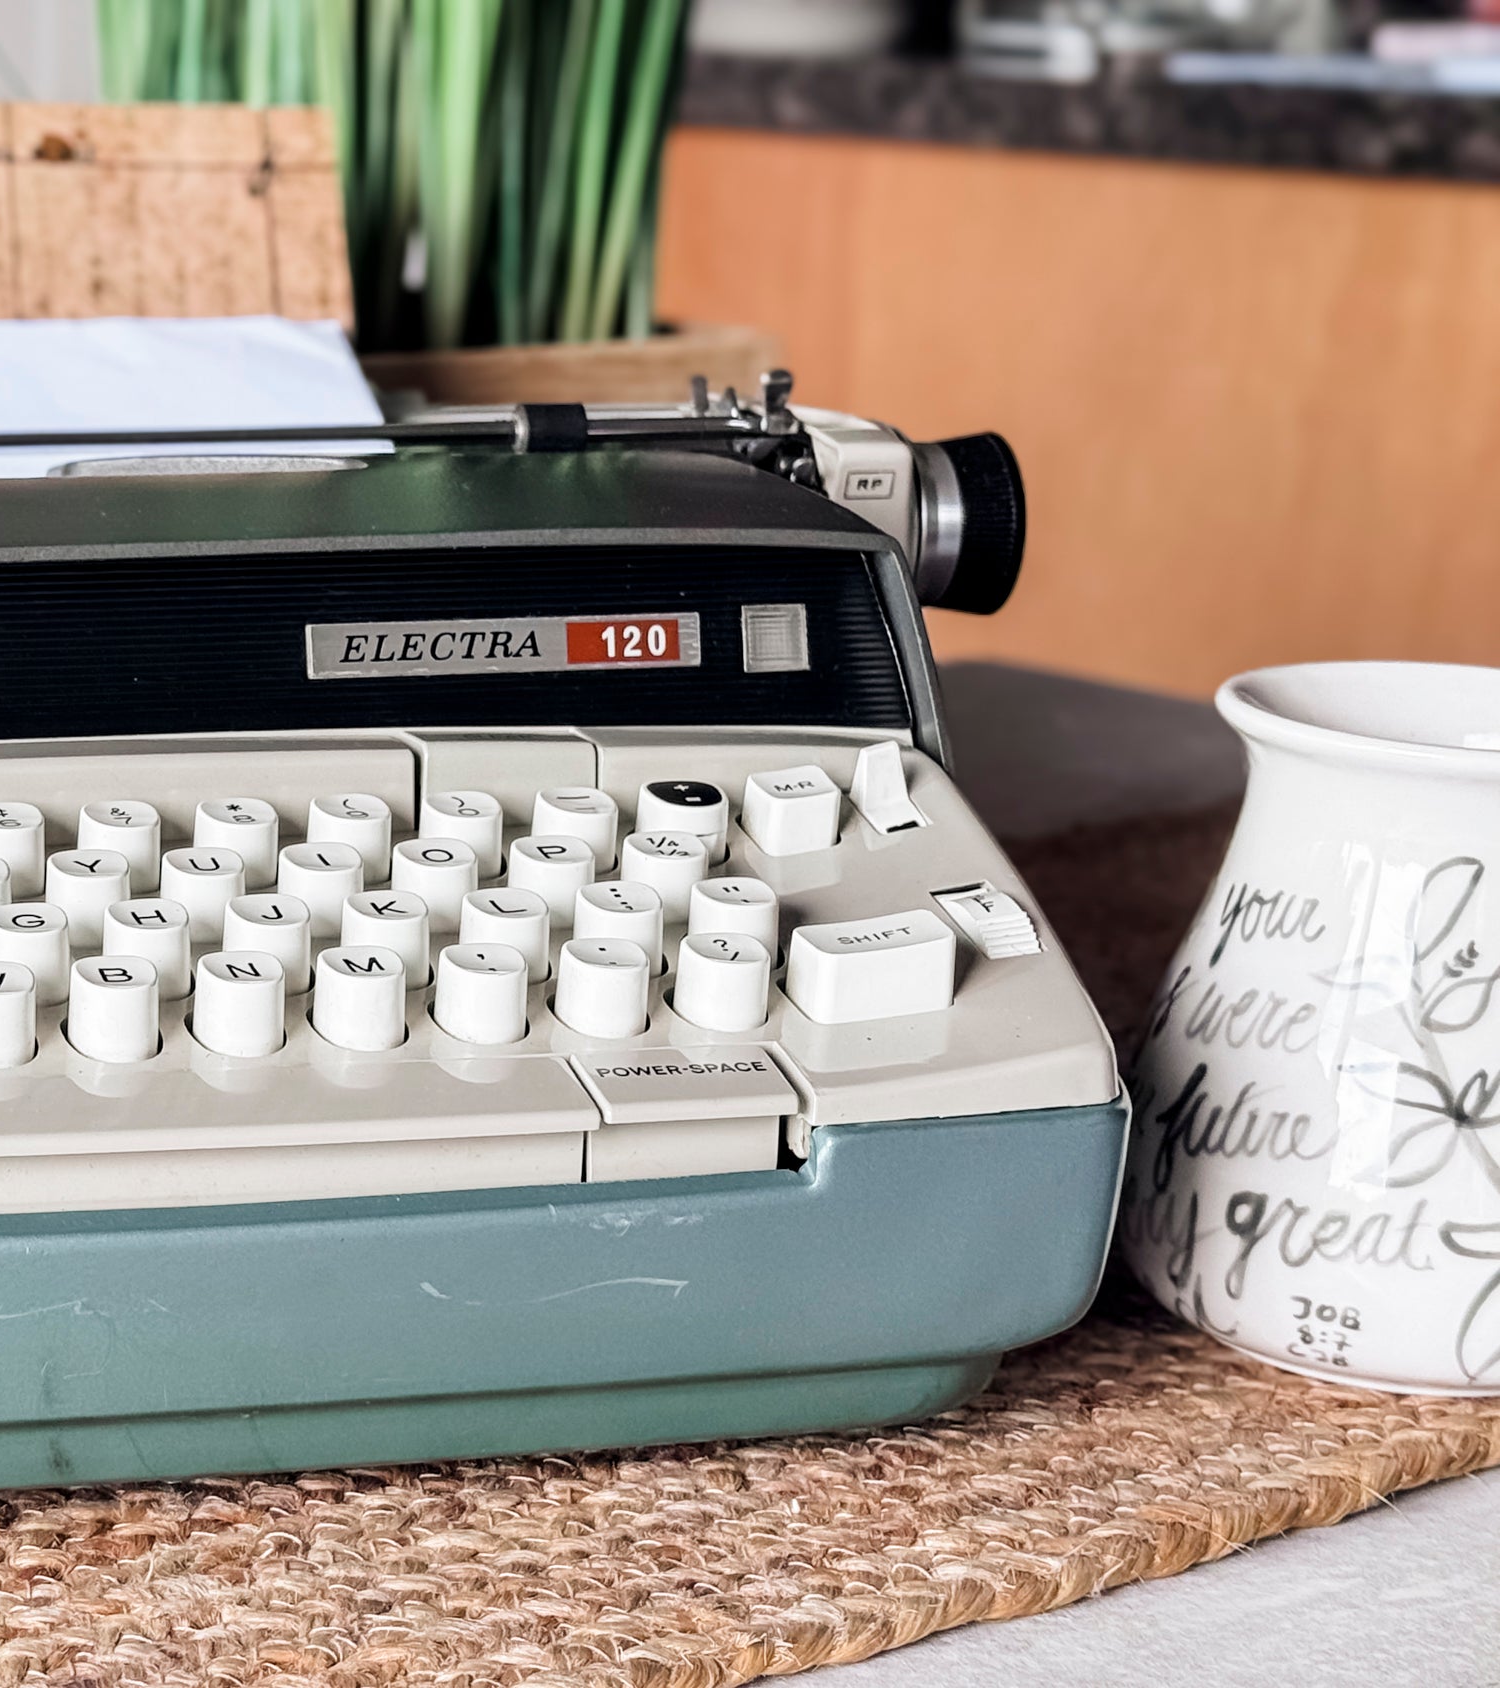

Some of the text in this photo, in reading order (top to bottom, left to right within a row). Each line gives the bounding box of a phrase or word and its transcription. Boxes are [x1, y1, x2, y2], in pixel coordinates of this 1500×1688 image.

[856, 479, 882, 491] RP
[339, 625, 668, 665] ELECTRA 120
[316, 853, 331, 867] I
[421, 849, 454, 863] O
[536, 845, 568, 860] P
[74, 859, 102, 873] Y
[188, 857, 221, 872] U
[260, 905, 284, 920] J
[369, 900, 409, 915] K
[489, 900, 528, 914] L
[11, 914, 46, 928] G
[130, 910, 168, 925] H
[1209, 883, 1327, 968] your
[837, 926, 912, 945] SHIFT
[225, 962, 263, 978] N
[342, 956, 385, 972] M
[98, 967, 134, 983] B
[1185, 981, 1320, 1054] were
[595, 1061, 767, 1078] POWER-SPACE
[1153, 1063, 1340, 1193] future
[1225, 1190, 1434, 1300] great
[1290, 1295, 1362, 1331] JOB
